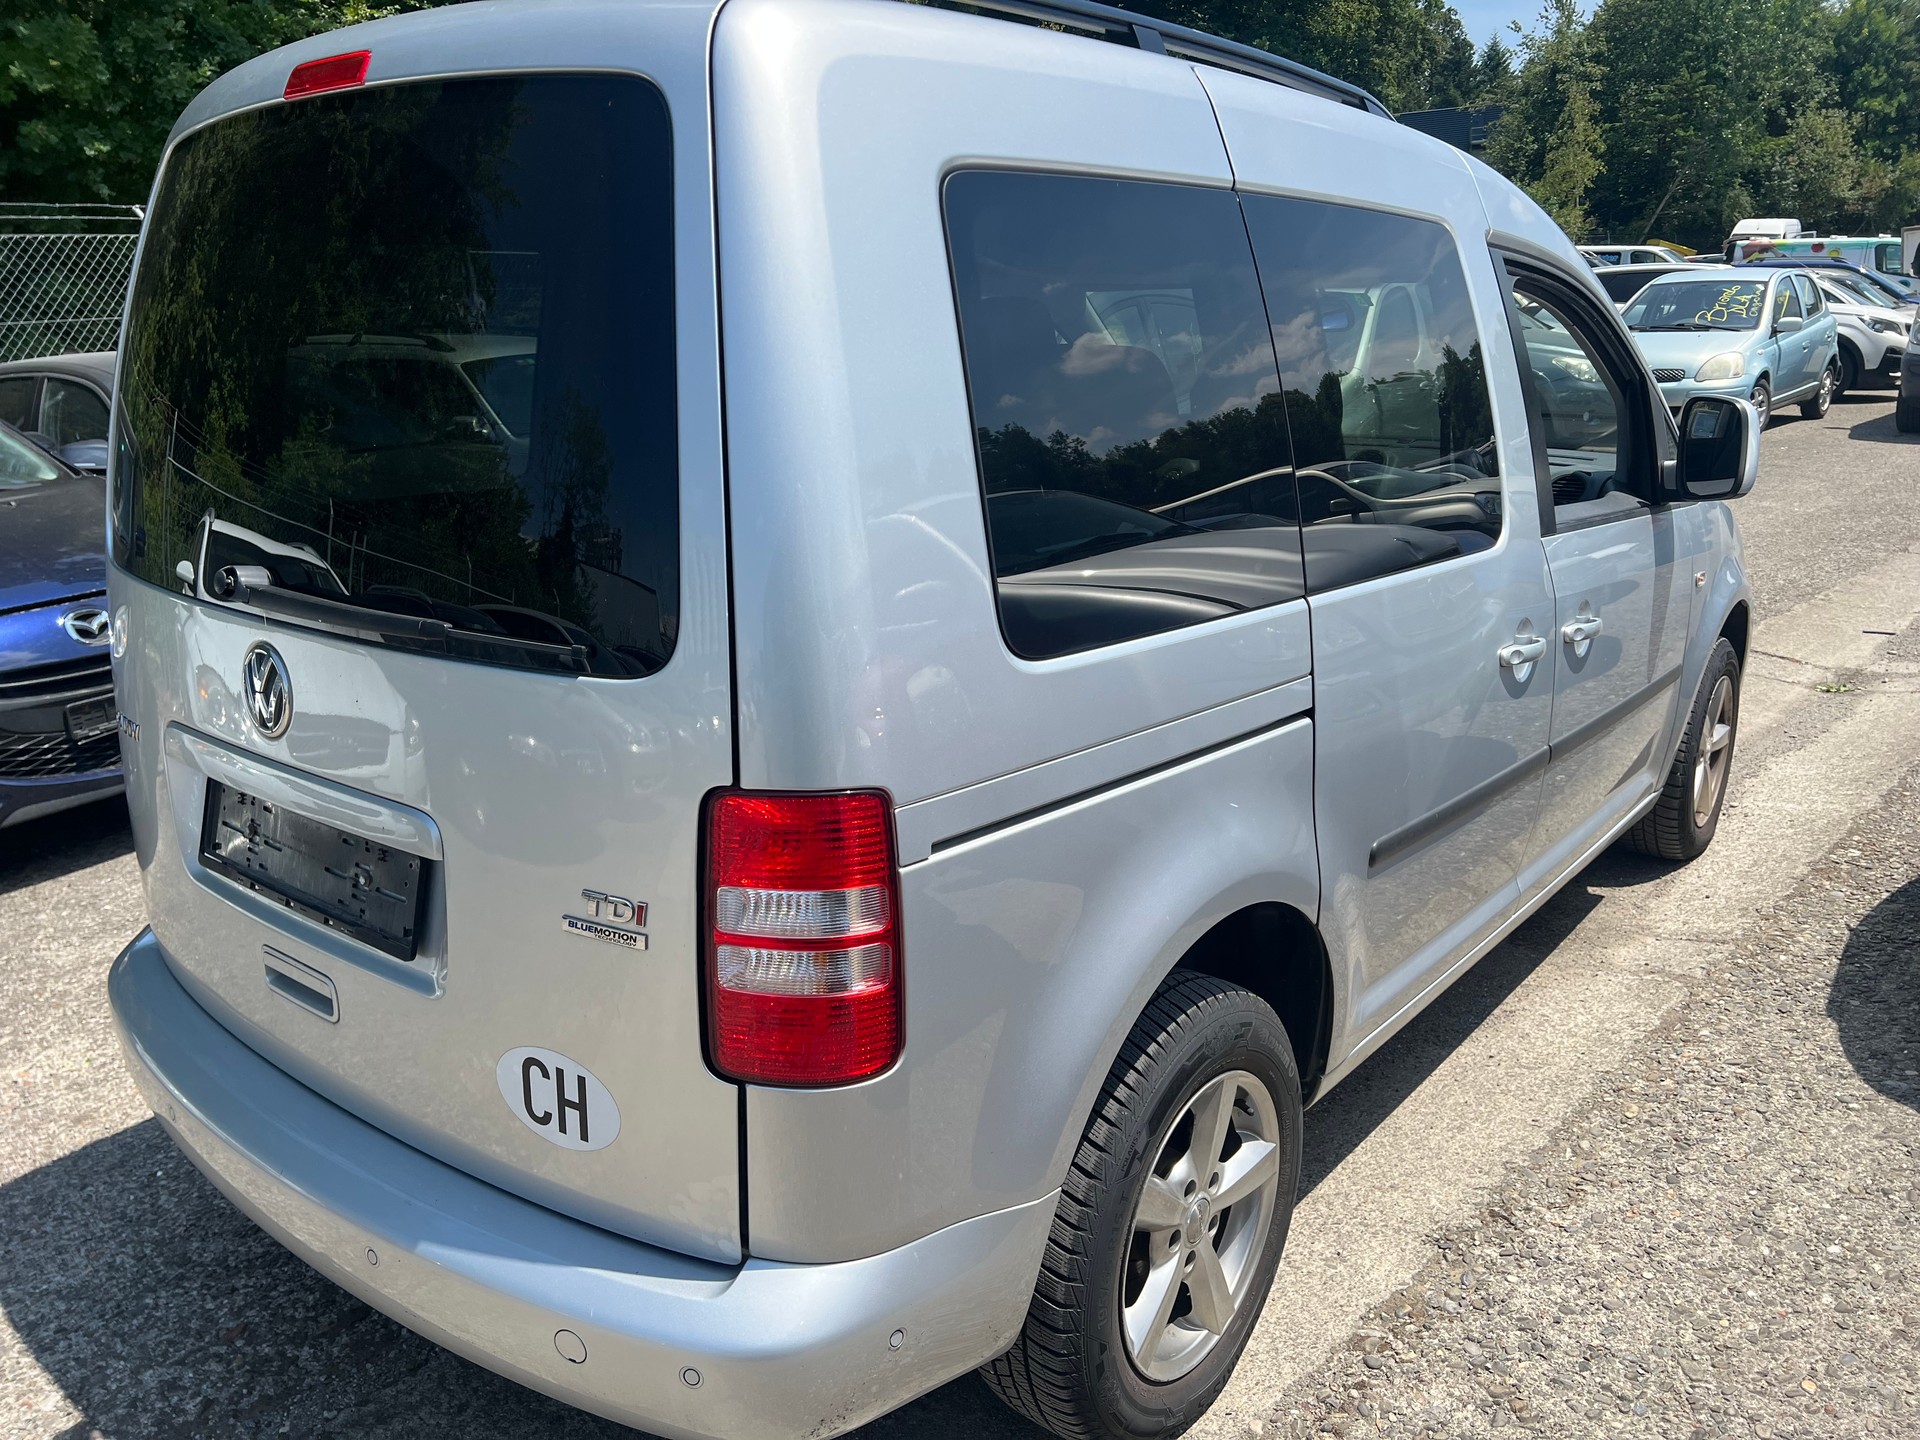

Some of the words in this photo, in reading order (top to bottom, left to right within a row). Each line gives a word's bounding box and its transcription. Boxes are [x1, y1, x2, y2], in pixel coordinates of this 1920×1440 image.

[581, 888, 648, 928] TDI
[567, 919, 638, 944] BLUEMOTION
[521, 1056, 589, 1143] CH
[1120, 1134, 1140, 1173] POLARIS
